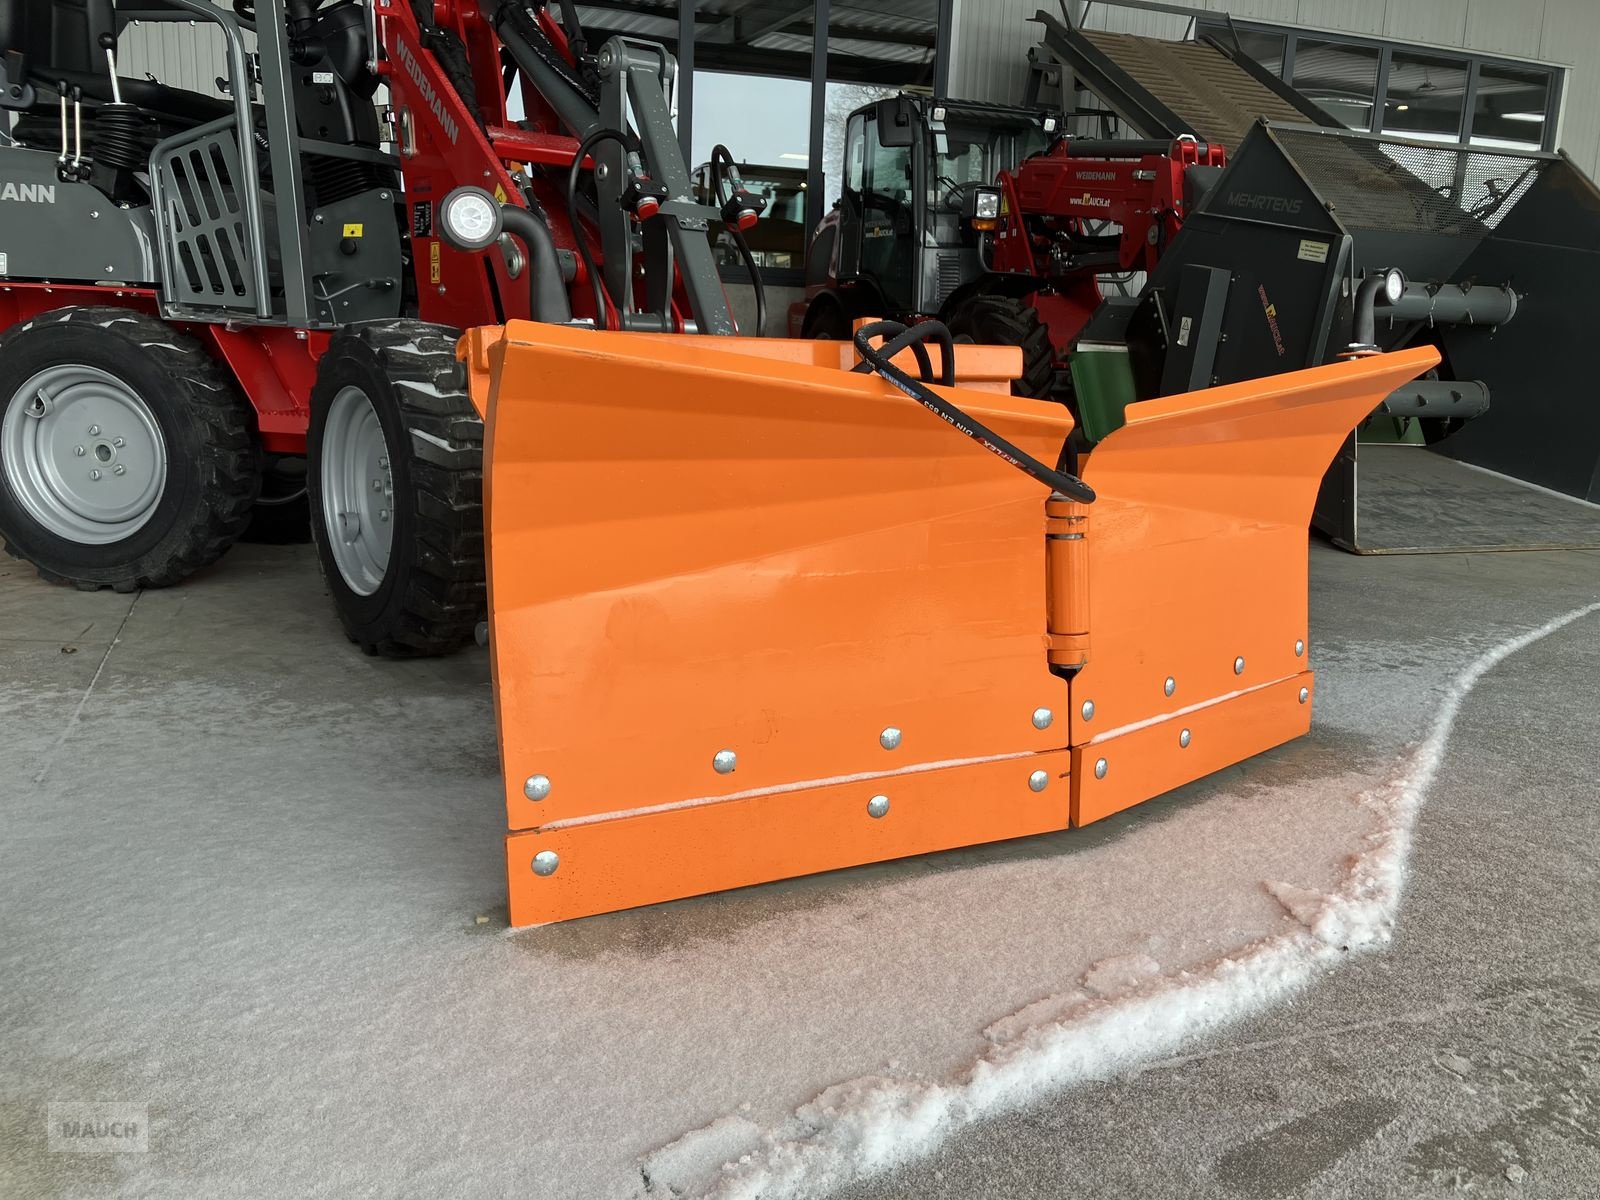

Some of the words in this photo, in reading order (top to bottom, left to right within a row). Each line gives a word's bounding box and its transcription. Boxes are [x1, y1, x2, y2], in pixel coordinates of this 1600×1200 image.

[396, 34, 458, 145] WEIDEMANN
[1076, 171, 1116, 181] WEIDEMANN
[0, 183, 55, 203] ANN
[1227, 191, 1303, 214] MEHRTENS
[941, 412, 955, 425] EN
[956, 422, 973, 437] DIN
